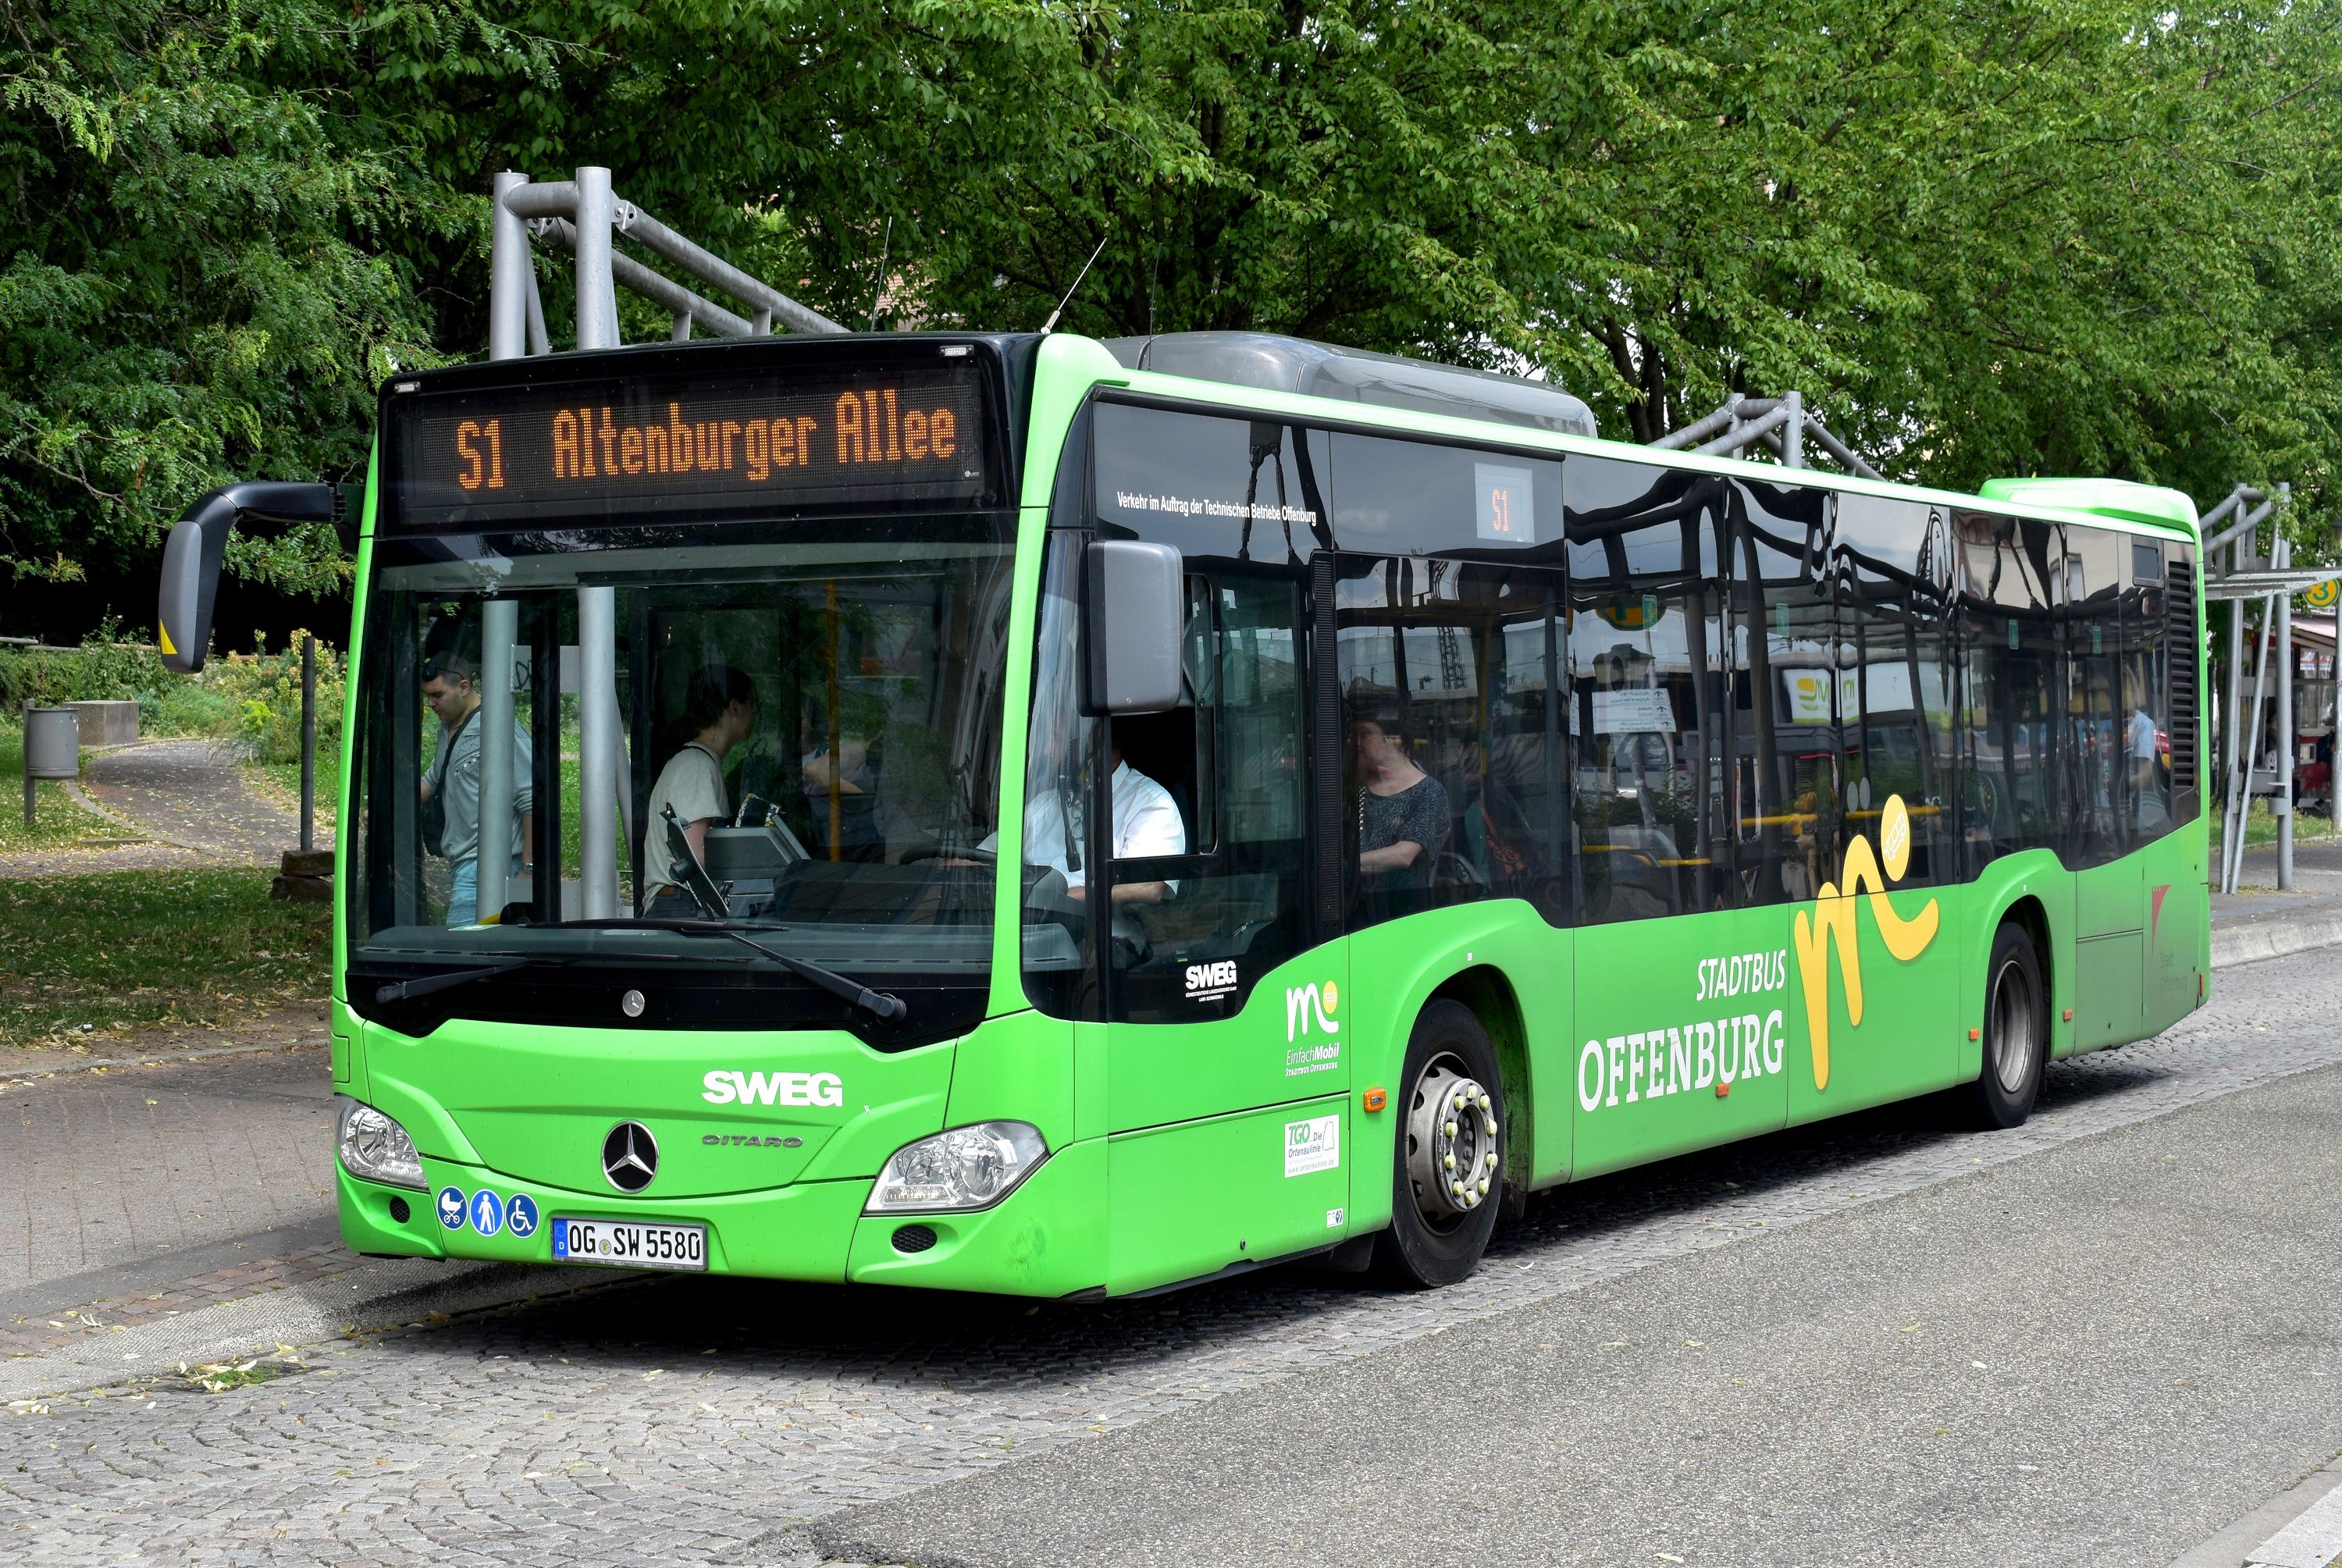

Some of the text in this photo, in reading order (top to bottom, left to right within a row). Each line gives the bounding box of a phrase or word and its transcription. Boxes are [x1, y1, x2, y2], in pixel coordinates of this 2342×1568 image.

[457, 388, 958, 489] S1 Altenburger Allee
[1117, 491, 1317, 526] Verkehr im Auftrag der Technischen Betriebe Offenburg
[1491, 487, 1511, 532] S1
[2312, 581, 2330, 601] 3
[1185, 960, 1237, 990] SWEG
[1696, 949, 1785, 1001] STADTBUS
[1286, 1041, 1340, 1065] EinfachMobil
[1578, 1010, 1784, 1112] OFFENBURG
[701, 1070, 843, 1108] SWEG
[701, 1133, 803, 1148] CITARO
[1288, 1122, 1322, 1146] TGO Die
[1288, 1143, 1321, 1158] Ortenaulinie
[558, 1241, 564, 1250] D
[569, 1225, 700, 1260] OG SW 5580
